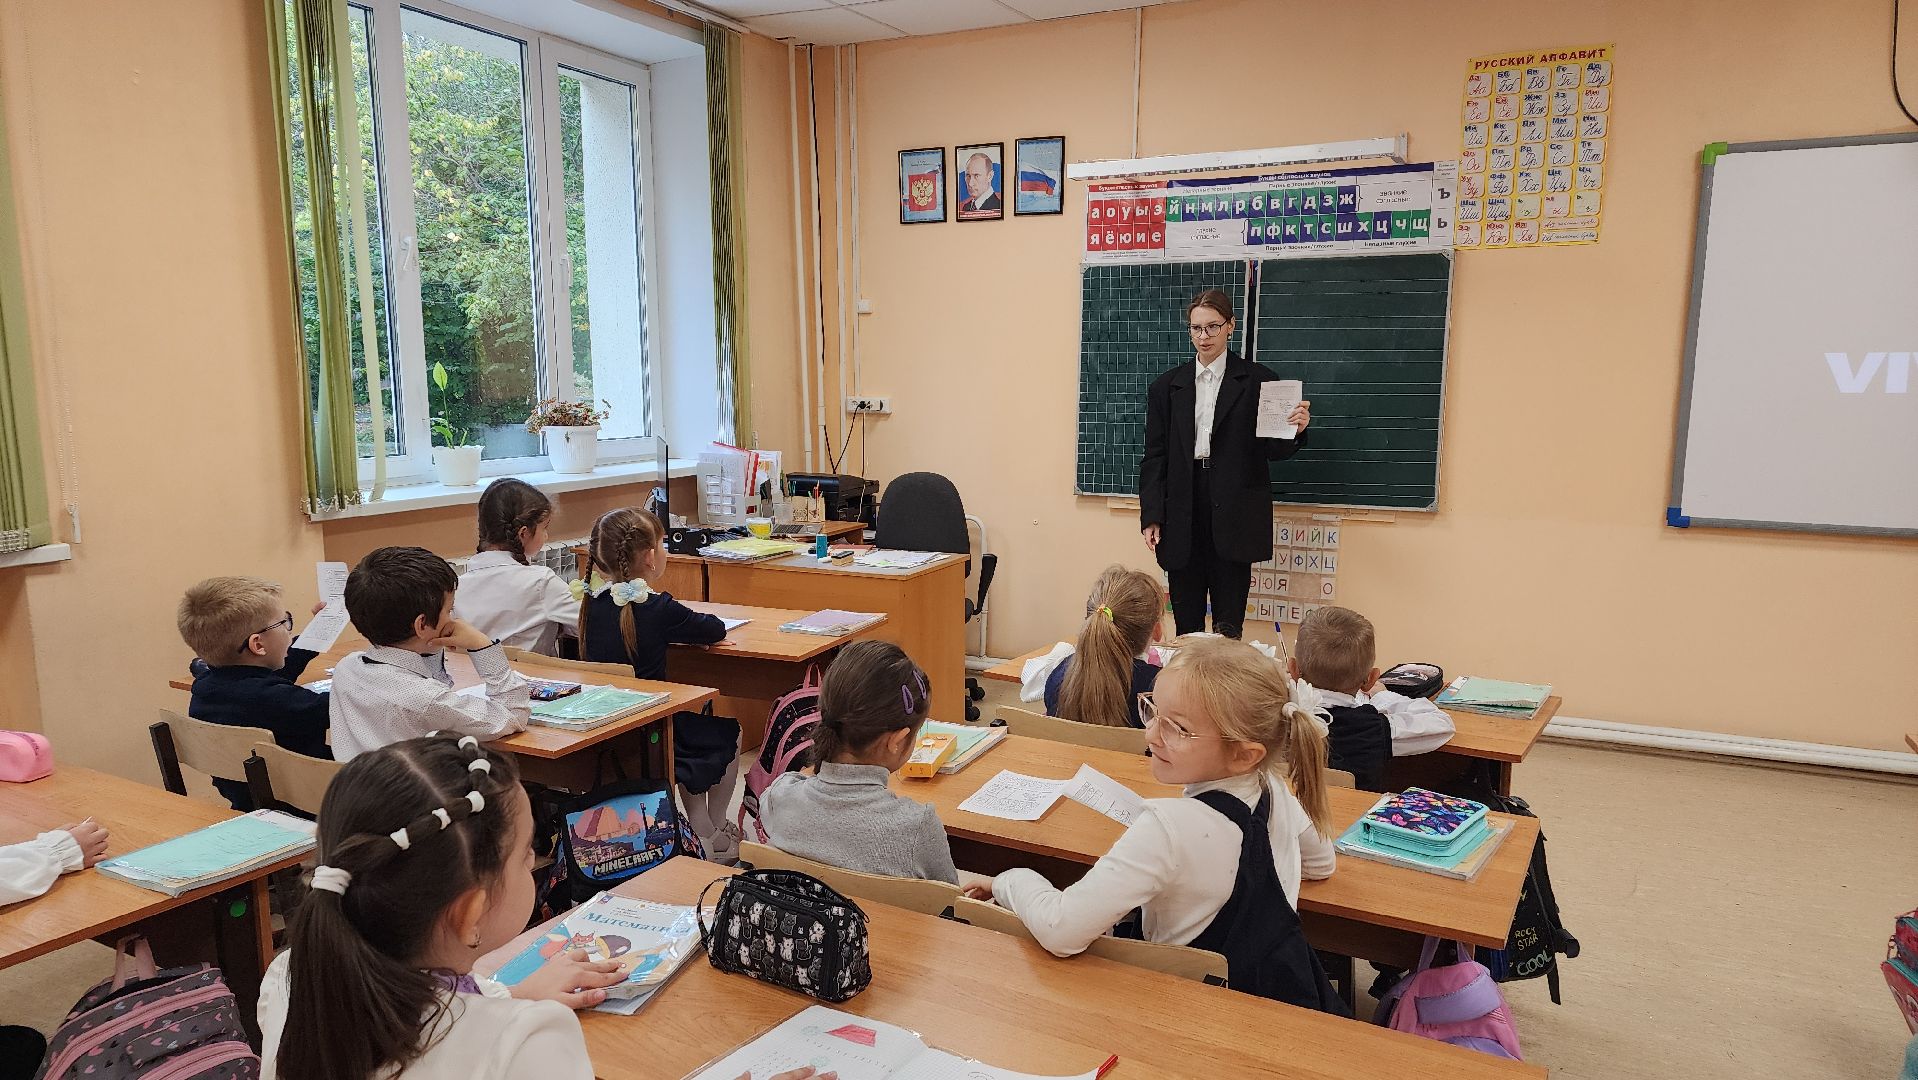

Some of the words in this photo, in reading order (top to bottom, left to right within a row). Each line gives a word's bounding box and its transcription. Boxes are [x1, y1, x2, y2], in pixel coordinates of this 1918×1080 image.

[1475, 55, 1534, 70] РУССКИЙ
[1540, 49, 1606, 63] АЛФАВИТ
[1824, 351, 1918, 394] VI
[1281, 529, 1289, 541] З
[1296, 530, 1305, 542] И
[1312, 528, 1321, 544] Й
[1328, 532, 1337, 544] К
[1280, 553, 1288, 565] У
[1295, 555, 1304, 567] Ф
[1309, 556, 1319, 569] Х
[1325, 557, 1335, 573] Ц
[1263, 578, 1273, 590] Ю
[1278, 579, 1288, 592] Я
[1323, 583, 1333, 595] О
[1261, 604, 1271, 617] Ы
[1277, 606, 1286, 618] Т
[1292, 608, 1300, 620] Е
[593, 848, 664, 876] MINECRAFT
[1517, 933, 1539, 951] STAR
[1517, 949, 1553, 975] COOL
